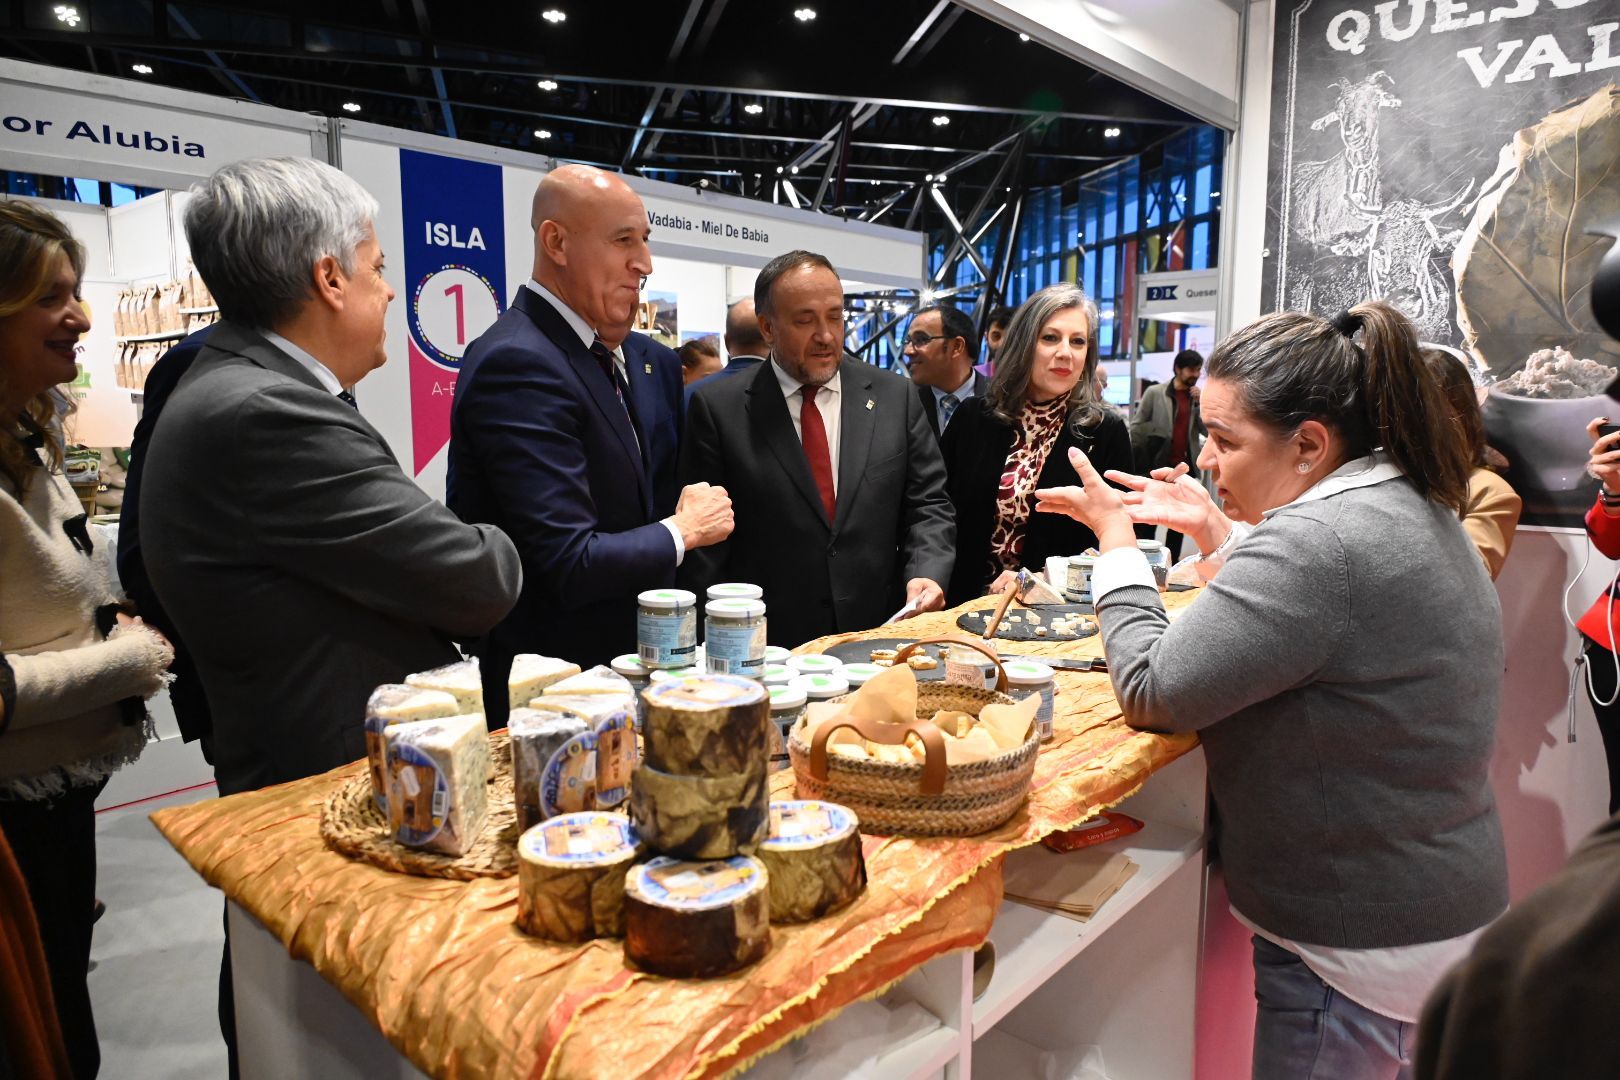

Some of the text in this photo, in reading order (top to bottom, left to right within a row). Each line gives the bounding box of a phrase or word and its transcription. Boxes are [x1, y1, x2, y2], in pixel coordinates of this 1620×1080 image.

[1325, 0, 1590, 55] QUE
[1457, 22, 1620, 88] VAL
[66, 120, 206, 158] Alubia
[425, 221, 487, 251] ISLA
[647, 210, 692, 231] Vadabia
[701, 220, 723, 236] Miel
[725, 224, 739, 238] De
[741, 227, 769, 243] Babia
[444, 283, 465, 345] 1
